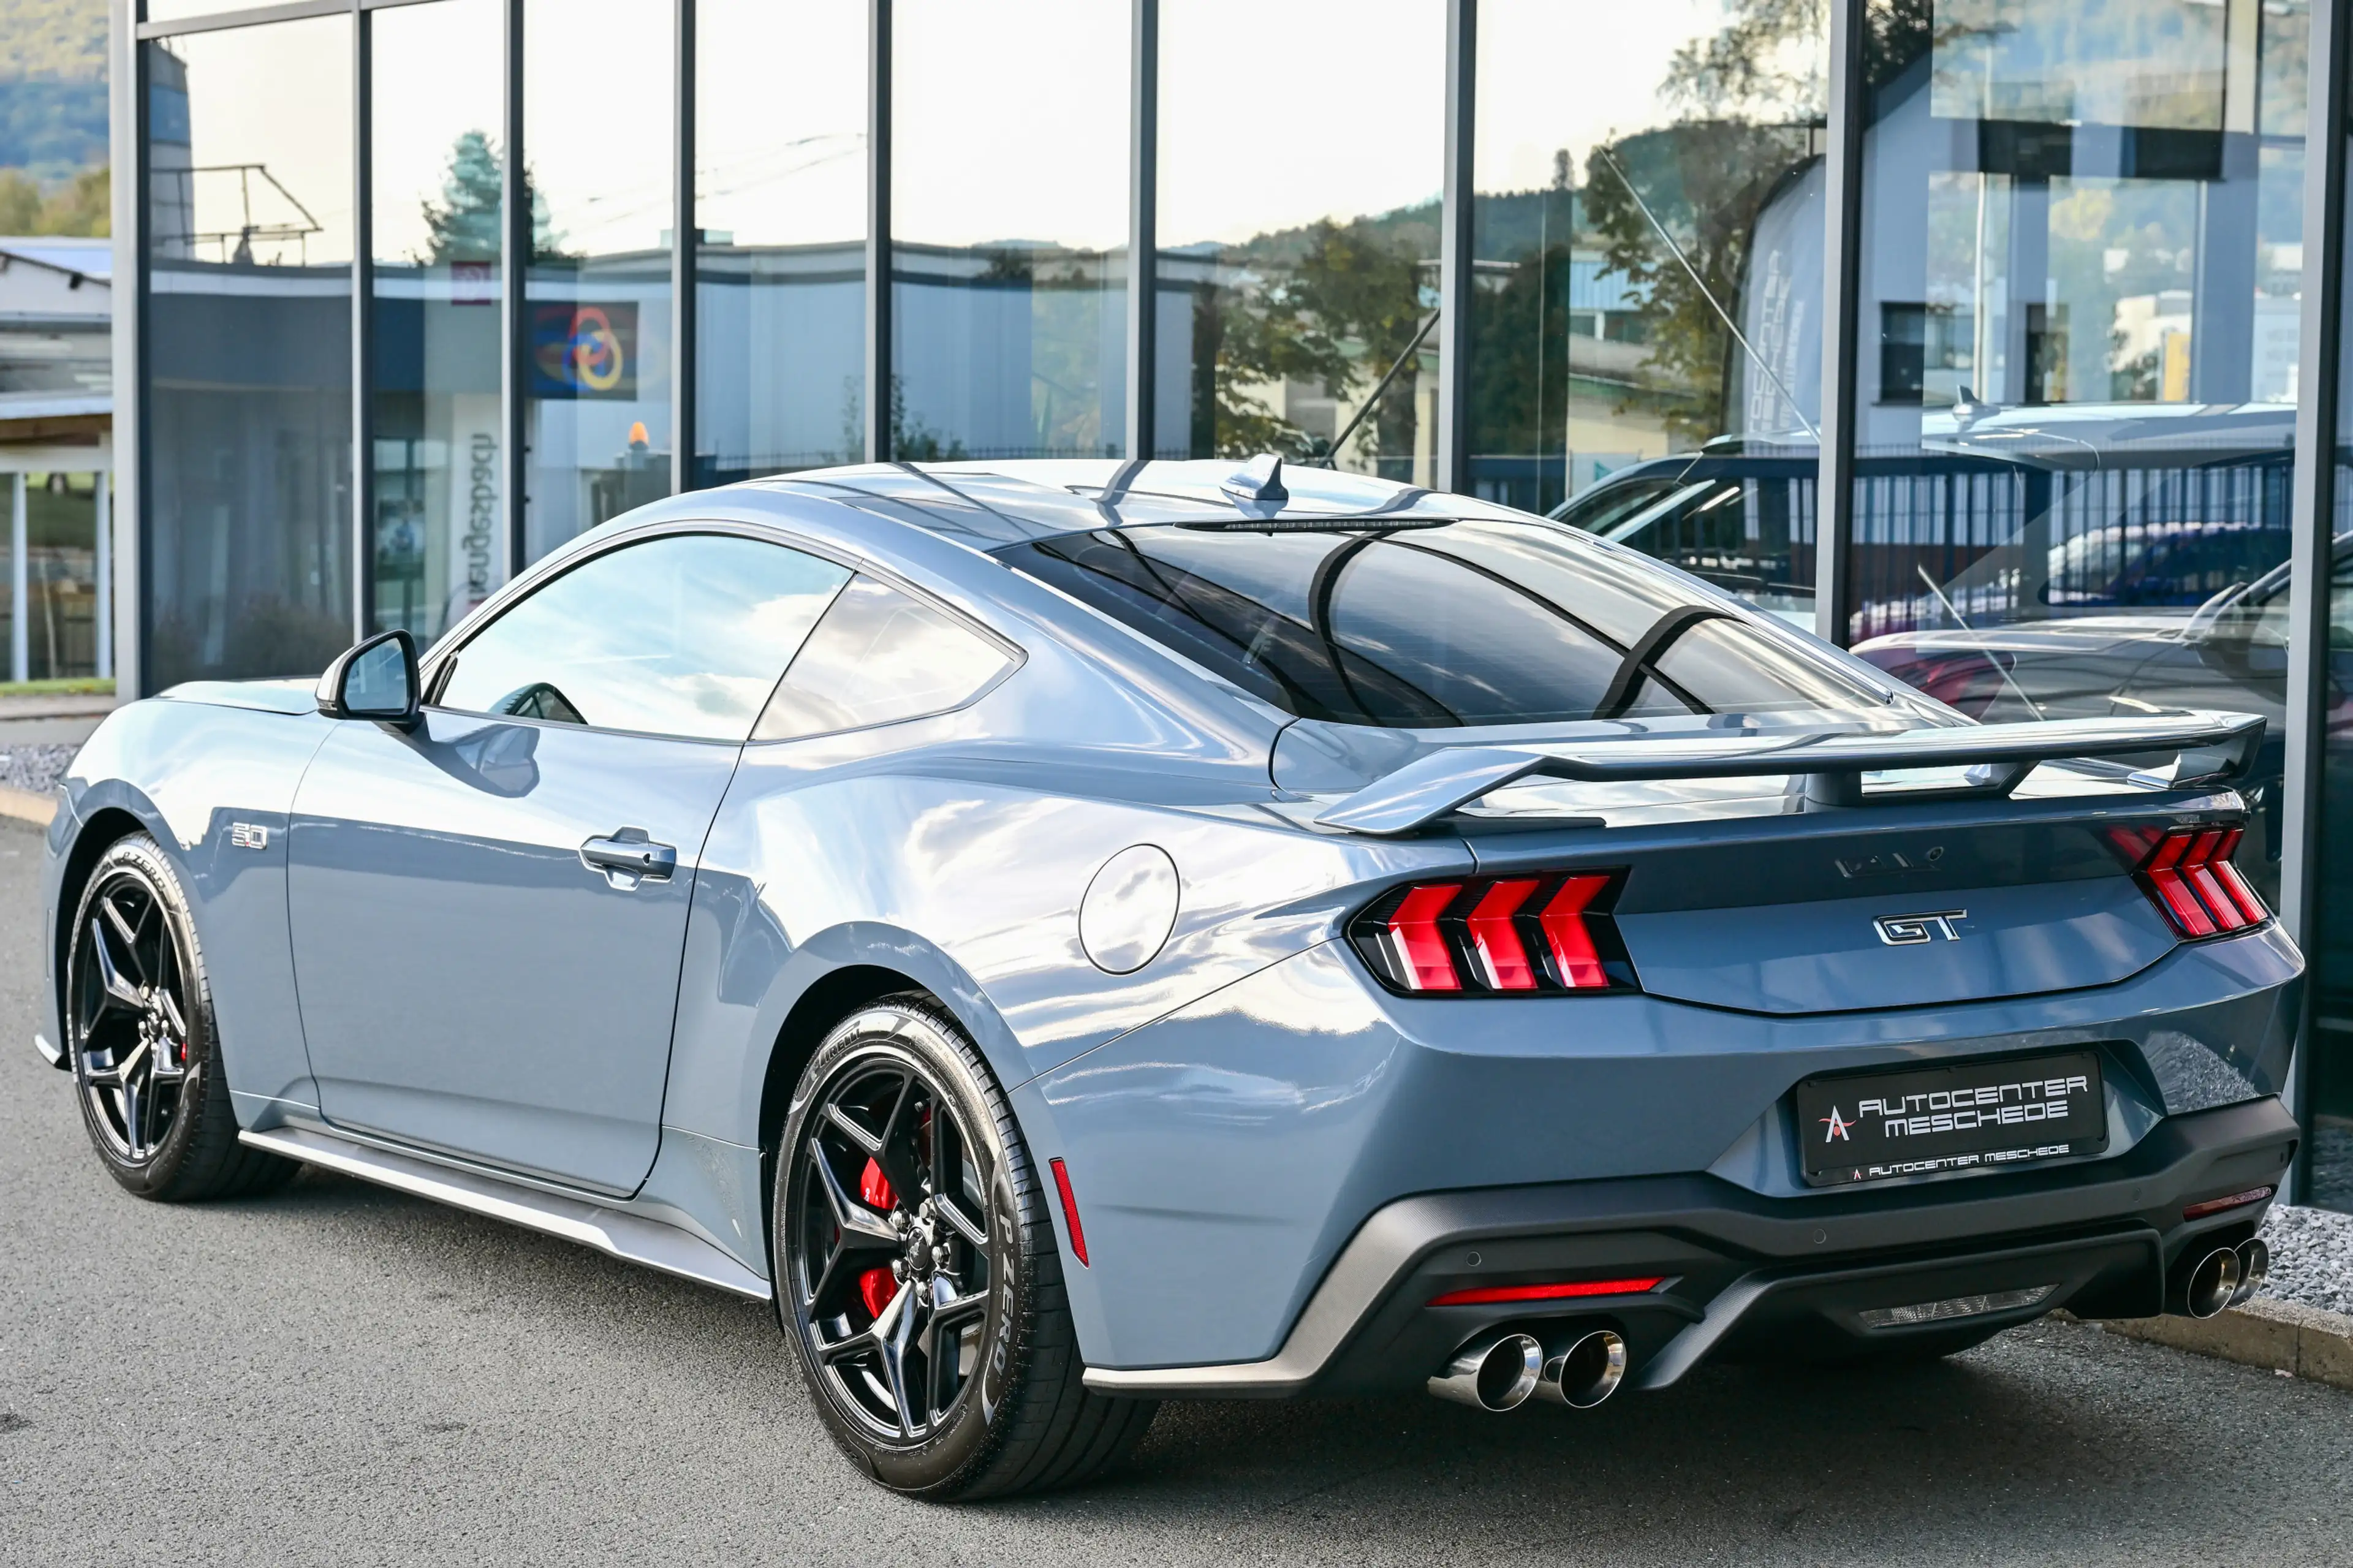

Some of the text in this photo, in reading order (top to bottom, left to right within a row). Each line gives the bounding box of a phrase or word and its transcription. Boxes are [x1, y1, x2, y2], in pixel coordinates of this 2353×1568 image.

[232, 822, 267, 850] 5.0
[132, 854, 166, 892] ZERO
[1872, 909, 1968, 946] GT
[1859, 1075, 2088, 1118] AUTOCENTER
[1885, 1100, 2069, 1138] MESCHEDE
[1869, 1154, 1979, 1176] AUTOCENTER
[1984, 1144, 2069, 1162] MESCHEDE
[993, 1214, 1015, 1376] P ZERO
